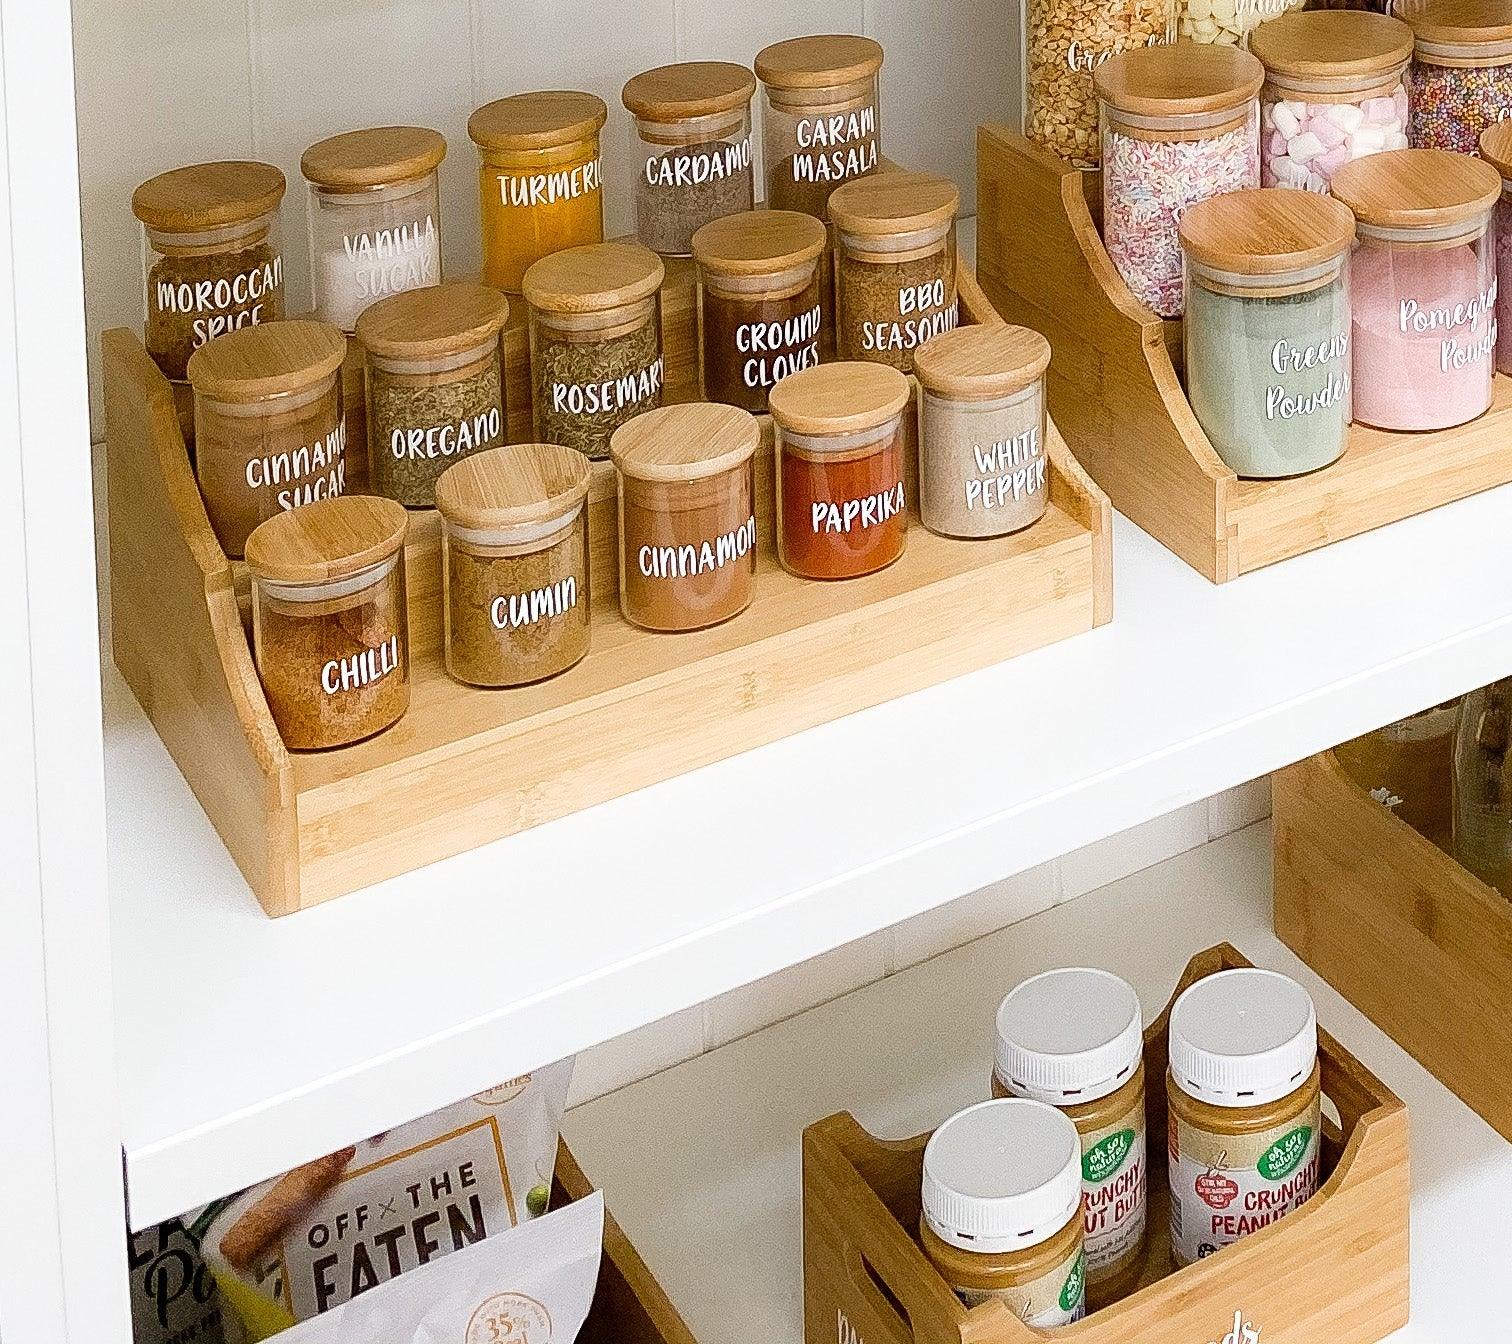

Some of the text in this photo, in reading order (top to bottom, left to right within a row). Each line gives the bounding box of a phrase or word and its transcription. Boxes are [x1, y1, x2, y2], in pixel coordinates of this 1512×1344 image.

[796, 105, 875, 149] GARAM
[645, 139, 752, 188] CARDAMO
[793, 140, 879, 183] MASALA
[343, 214, 436, 264] VANILLA
[156, 255, 284, 315] MOROCCAN
[898, 278, 946, 317] BBQ
[1399, 275, 1499, 337] Pomegra
[736, 304, 822, 354] GROUND
[1271, 329, 1349, 376] Greens
[1265, 371, 1353, 421] Powder
[245, 416, 347, 490] CINNAMO
[391, 407, 501, 462] OREGANO
[973, 425, 1041, 475] WHITE
[811, 479, 906, 534] PAPRIKA
[964, 461, 1047, 511] PEPPER
[637, 514, 757, 578] CINNAMON
[489, 574, 578, 630] CUMIN
[321, 634, 400, 696] CHILLI
[306, 1161, 477, 1250] OFF THE
